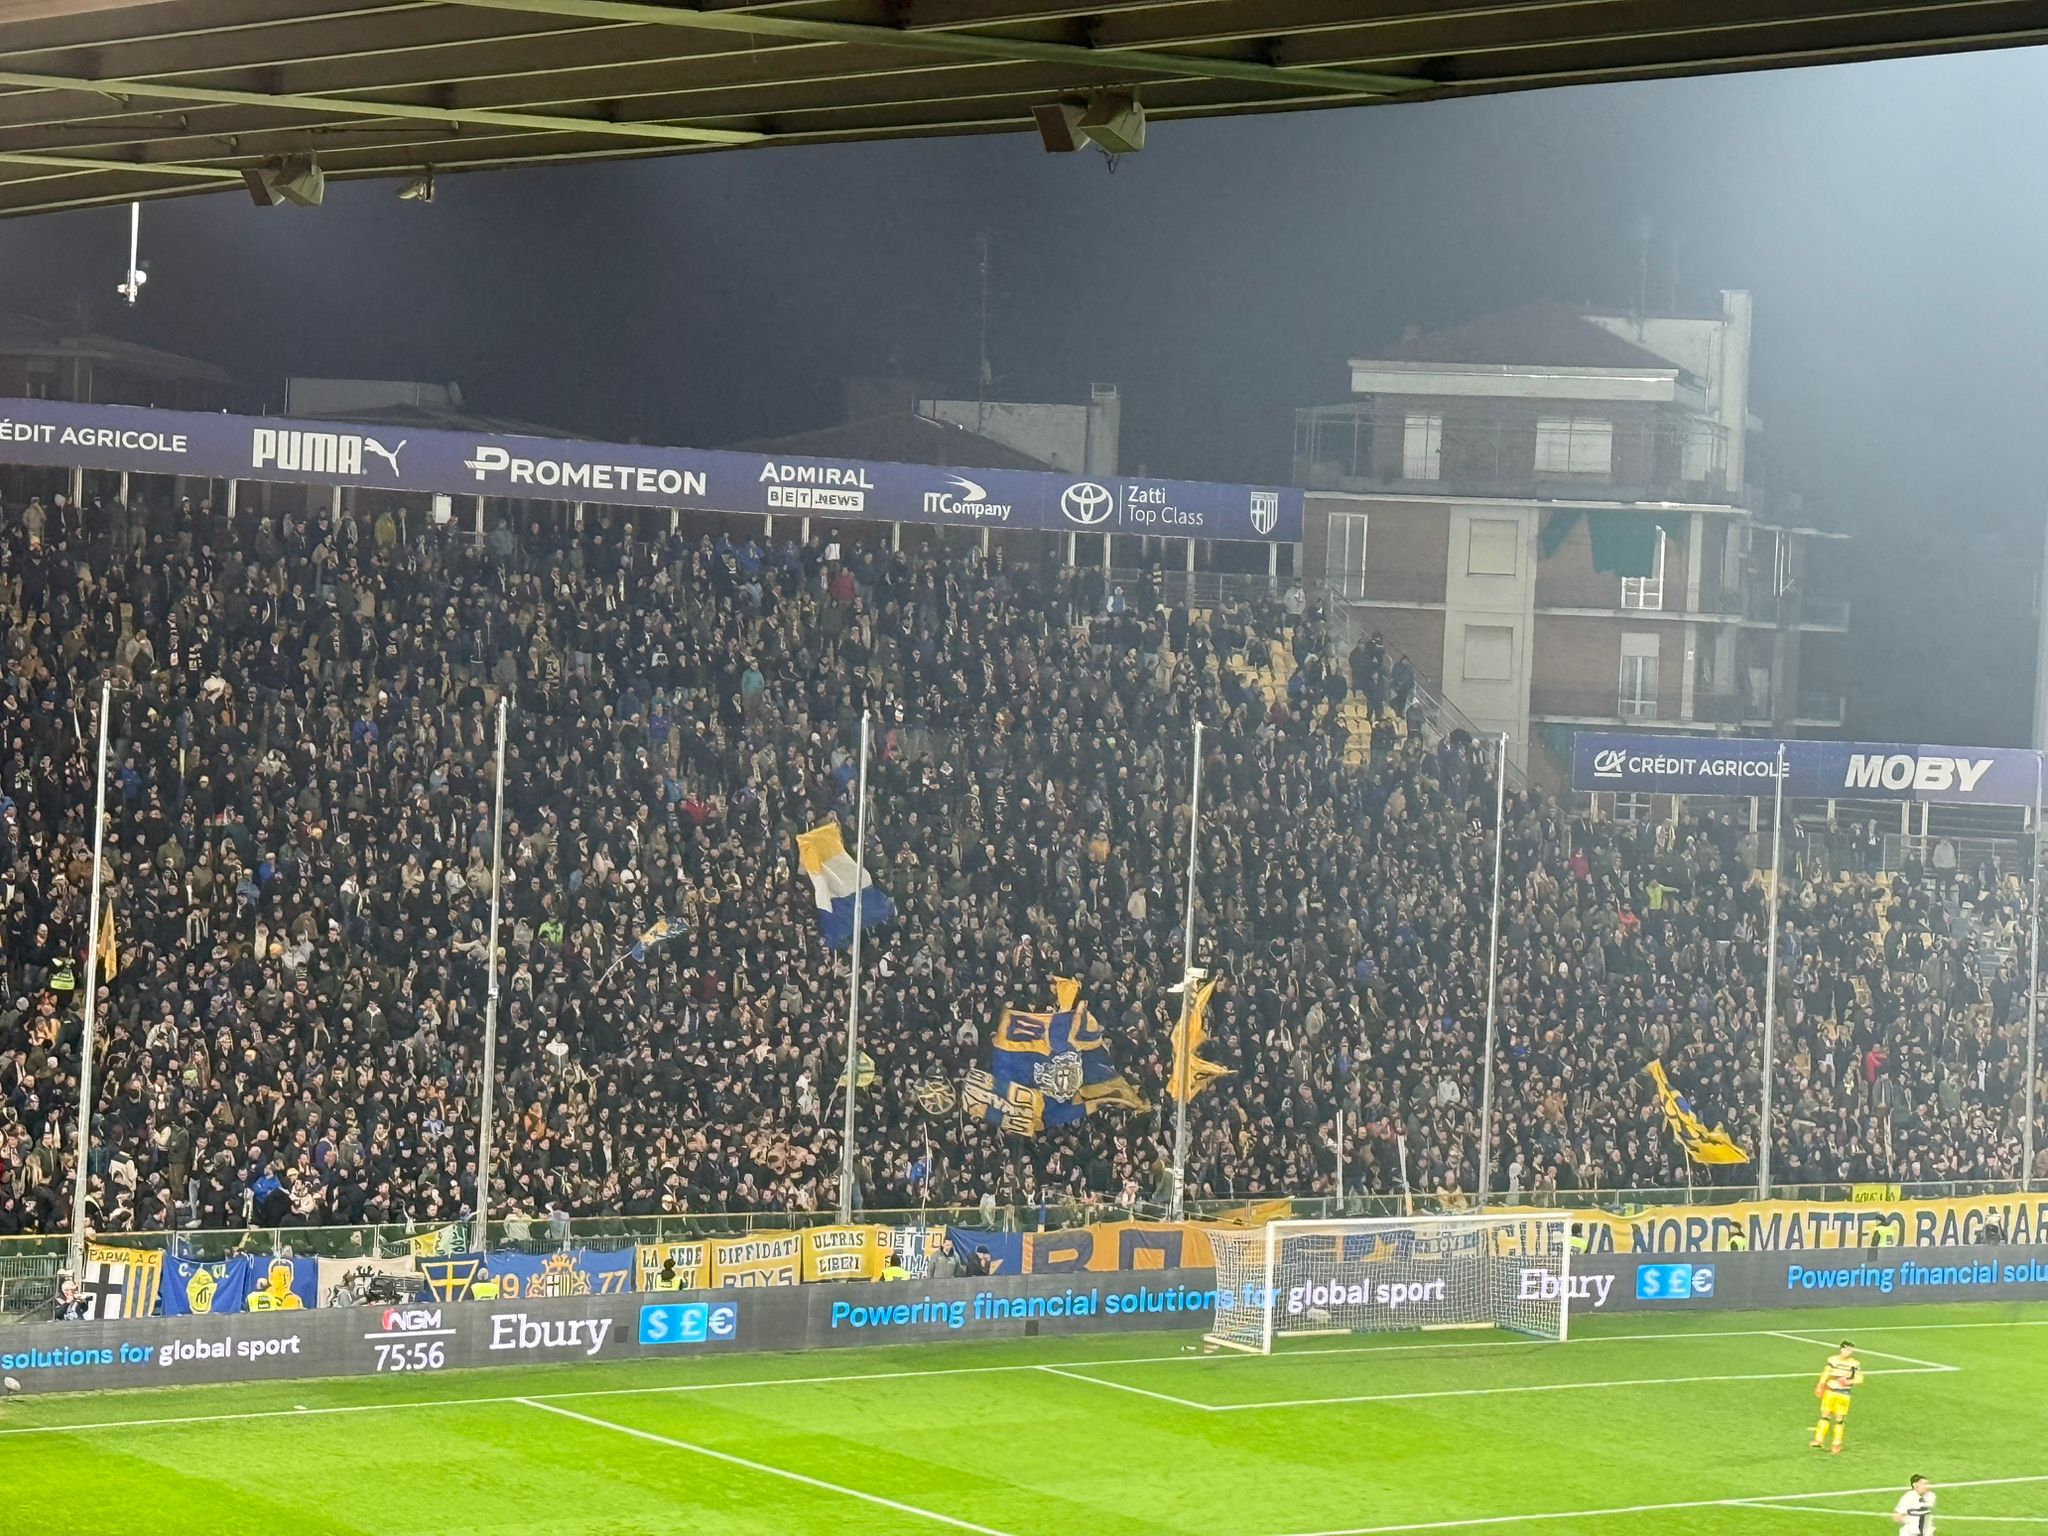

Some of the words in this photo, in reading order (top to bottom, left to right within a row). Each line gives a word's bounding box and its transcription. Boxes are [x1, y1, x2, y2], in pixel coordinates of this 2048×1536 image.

[60, 426, 188, 453] AGRICOLE
[252, 429, 362, 475] PUMA
[464, 446, 706, 496] PROMETEON
[760, 462, 874, 489] ADMIRAL
[1128, 486, 1167, 504] Zatti
[1128, 505, 1157, 526] Top
[1162, 506, 1204, 526] Class
[1628, 754, 1697, 775] CRÉDIT
[1699, 759, 1790, 778] AGRICOLE
[1845, 754, 1994, 792] MOBY
[813, 1232, 865, 1249] ULTRAS
[1749, 1211, 1905, 1251] MATTEO
[89, 1250, 130, 1262] PARMA
[642, 1250, 658, 1268] LA
[718, 1236, 799, 1265] DIFFIDATI
[598, 1269, 628, 1294] 77
[1516, 1269, 1615, 1306] Ebury
[1787, 1263, 1894, 1293] Powering
[1900, 1259, 1998, 1286] financial
[832, 1294, 965, 1329] Powering
[974, 1288, 1098, 1320] financial
[1105, 1284, 1235, 1316] solutions
[1243, 1282, 1280, 1308] for
[1288, 1277, 1370, 1316] global
[1376, 1278, 1446, 1309] sport
[382, 1308, 442, 1331] NGM
[489, 1313, 612, 1355] Ebury
[1, 1347, 113, 1370] solutions
[119, 1342, 153, 1365] for
[159, 1335, 231, 1366] global
[238, 1334, 300, 1362] sport
[374, 1341, 445, 1371] 75:56
